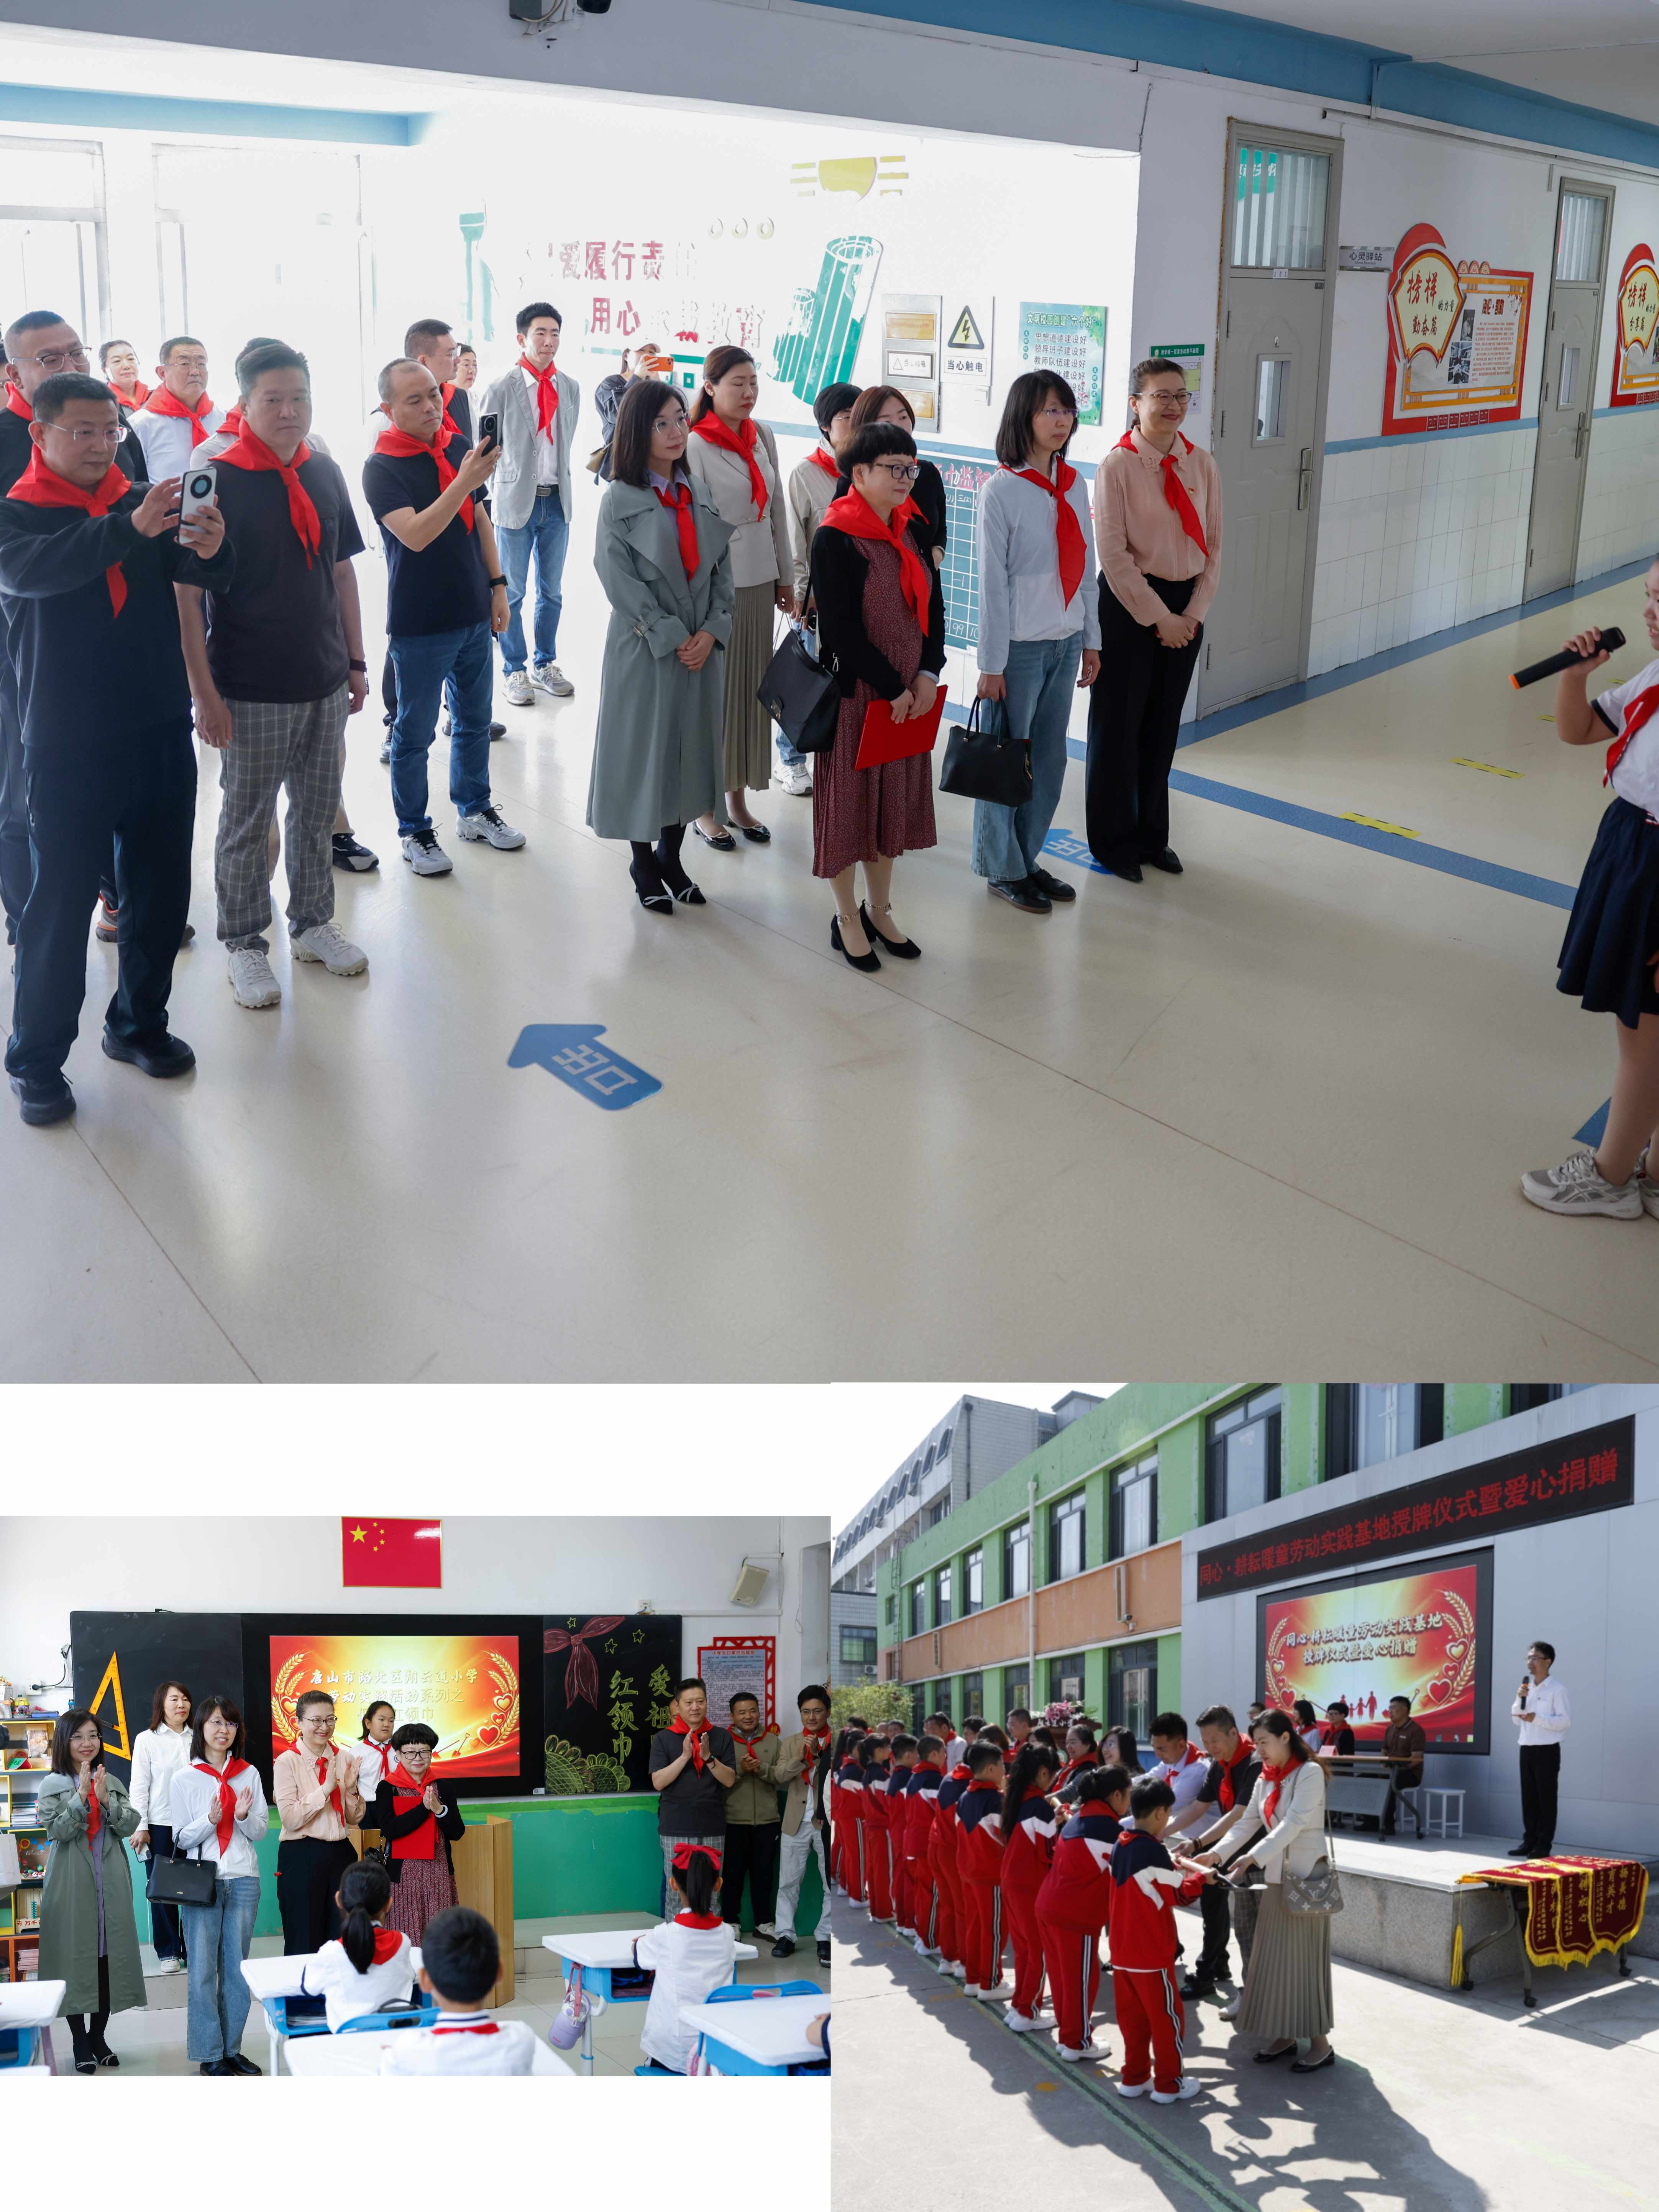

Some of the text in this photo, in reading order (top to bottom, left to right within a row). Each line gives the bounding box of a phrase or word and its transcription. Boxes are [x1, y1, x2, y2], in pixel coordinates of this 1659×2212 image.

[1349, 252, 1383, 261] 心灵驿站
[1407, 270, 1437, 307] 榜样
[1628, 282, 1647, 310] 榜样
[1438, 299, 1455, 312] 的力量
[1412, 314, 1437, 336] 勤奋篇
[1630, 316, 1645, 331] 分享篇
[1035, 332, 1087, 344] 思想道德建设好
[1034, 344, 1086, 357] 领导班子建设好
[947, 359, 983, 372] 当心触电
[1034, 356, 1086, 369] 教师队伍建设好
[935, 463, 997, 490] 巾监督
[952, 623, 964, 635] 99
[551, 1043, 638, 1095] 出口
[1303, 1637, 1418, 1666] 授牌仪式暨爱心捐赠
[310, 1668, 478, 1685] 唐山市路北区翔云道小学
[327, 1688, 465, 1704] 劳动实践活动系列之
[645, 1663, 674, 1744] 爱祖
[358, 1707, 434, 1722] 佩红领巾
[607, 1670, 639, 1766] 红领巾
